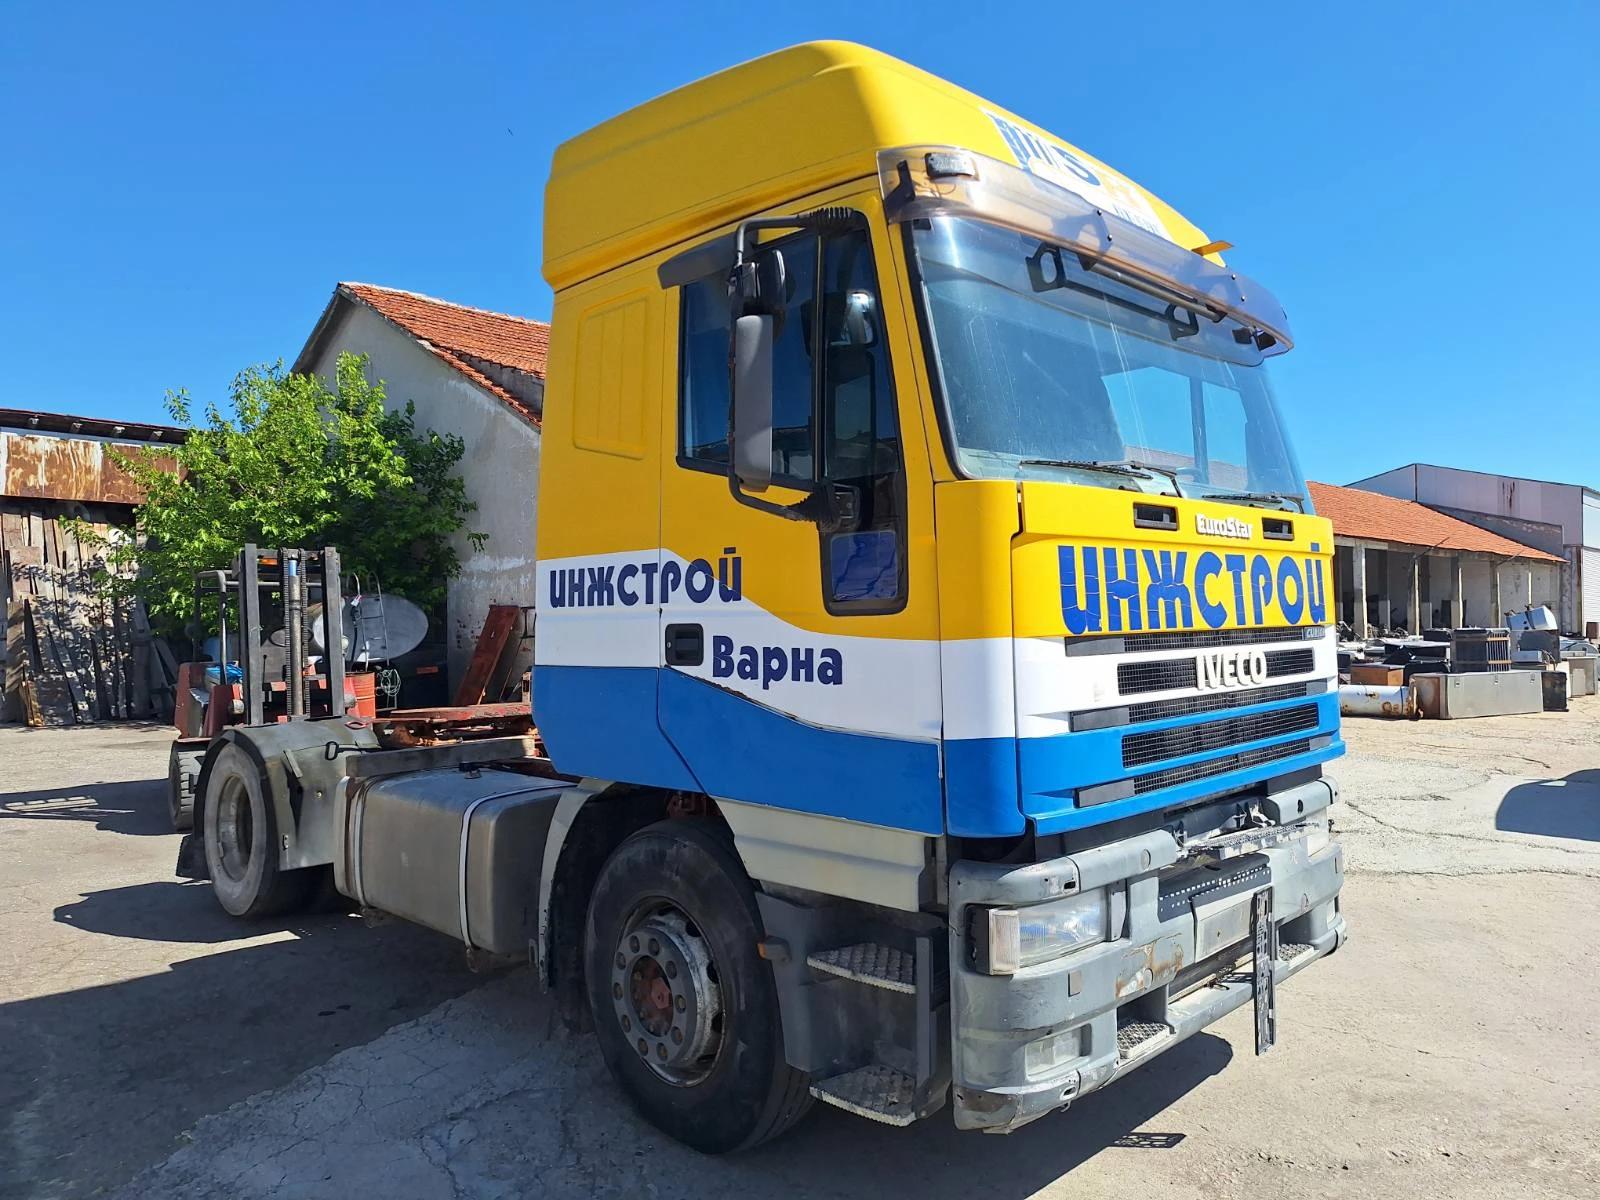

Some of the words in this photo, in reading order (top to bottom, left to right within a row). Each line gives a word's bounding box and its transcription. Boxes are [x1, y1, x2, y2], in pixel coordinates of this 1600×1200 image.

[1196, 513, 1253, 539] EuroStar
[550, 547, 742, 608] ИНЖСТРОЙ
[1058, 543, 1326, 635] ИНЖСТРОЙ
[712, 635, 843, 690] Варна
[1196, 651, 1268, 691] IVECO
